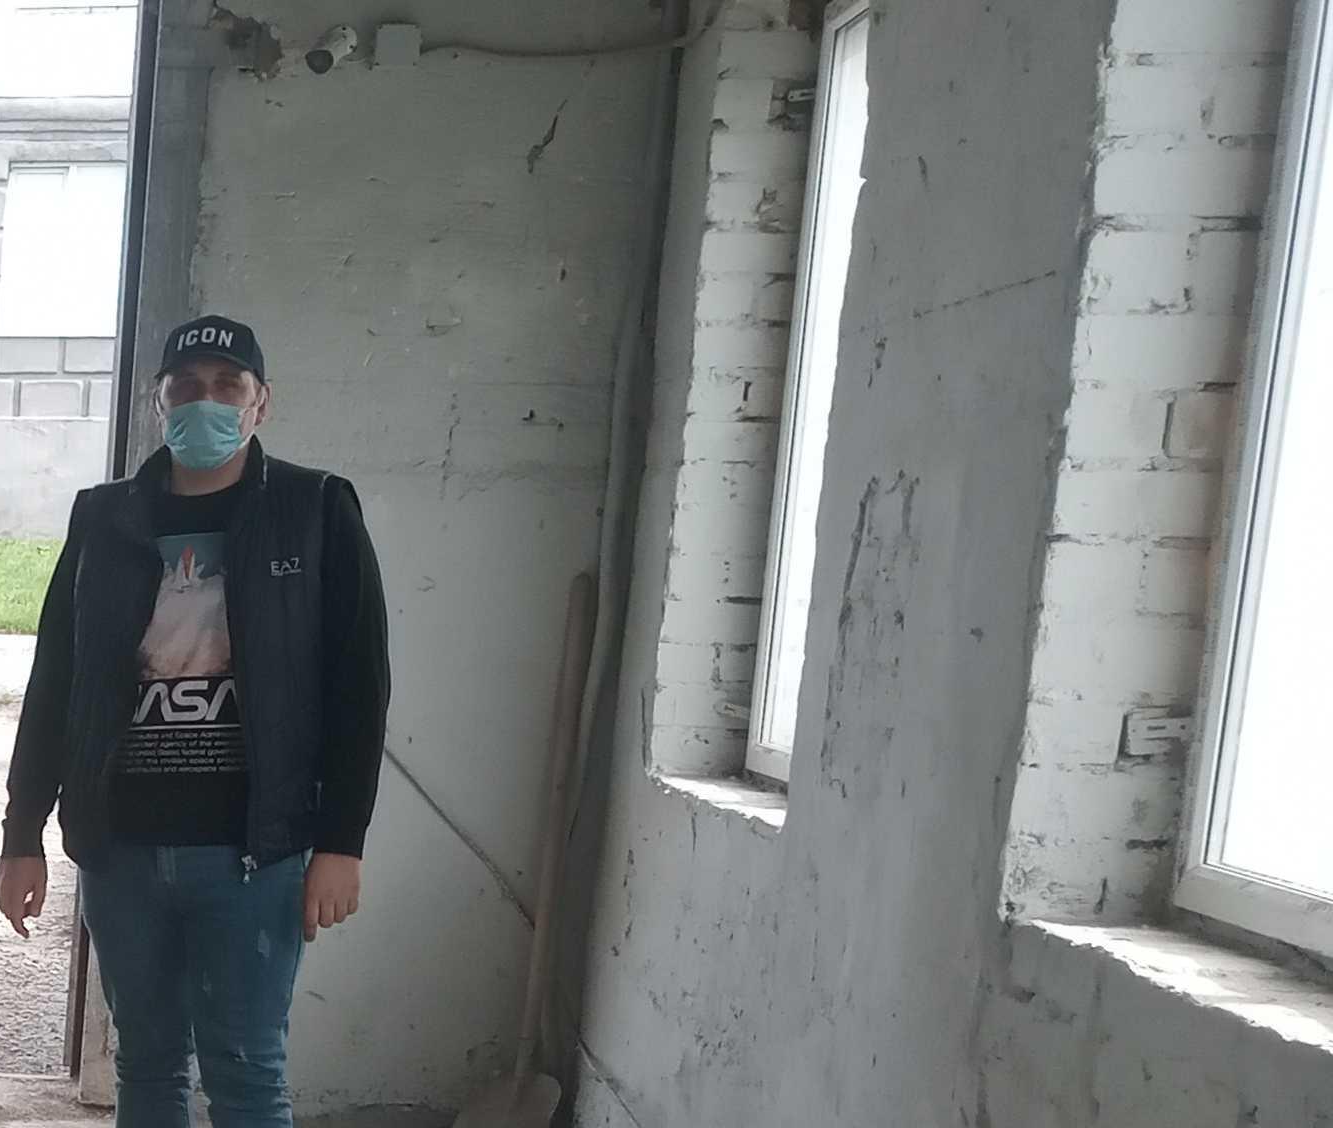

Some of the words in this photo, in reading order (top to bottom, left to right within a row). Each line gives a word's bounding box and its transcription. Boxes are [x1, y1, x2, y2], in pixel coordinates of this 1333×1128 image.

[177, 327, 233, 351] ICON
[270, 557, 299, 573] EA7
[132, 679, 238, 723] ASA
